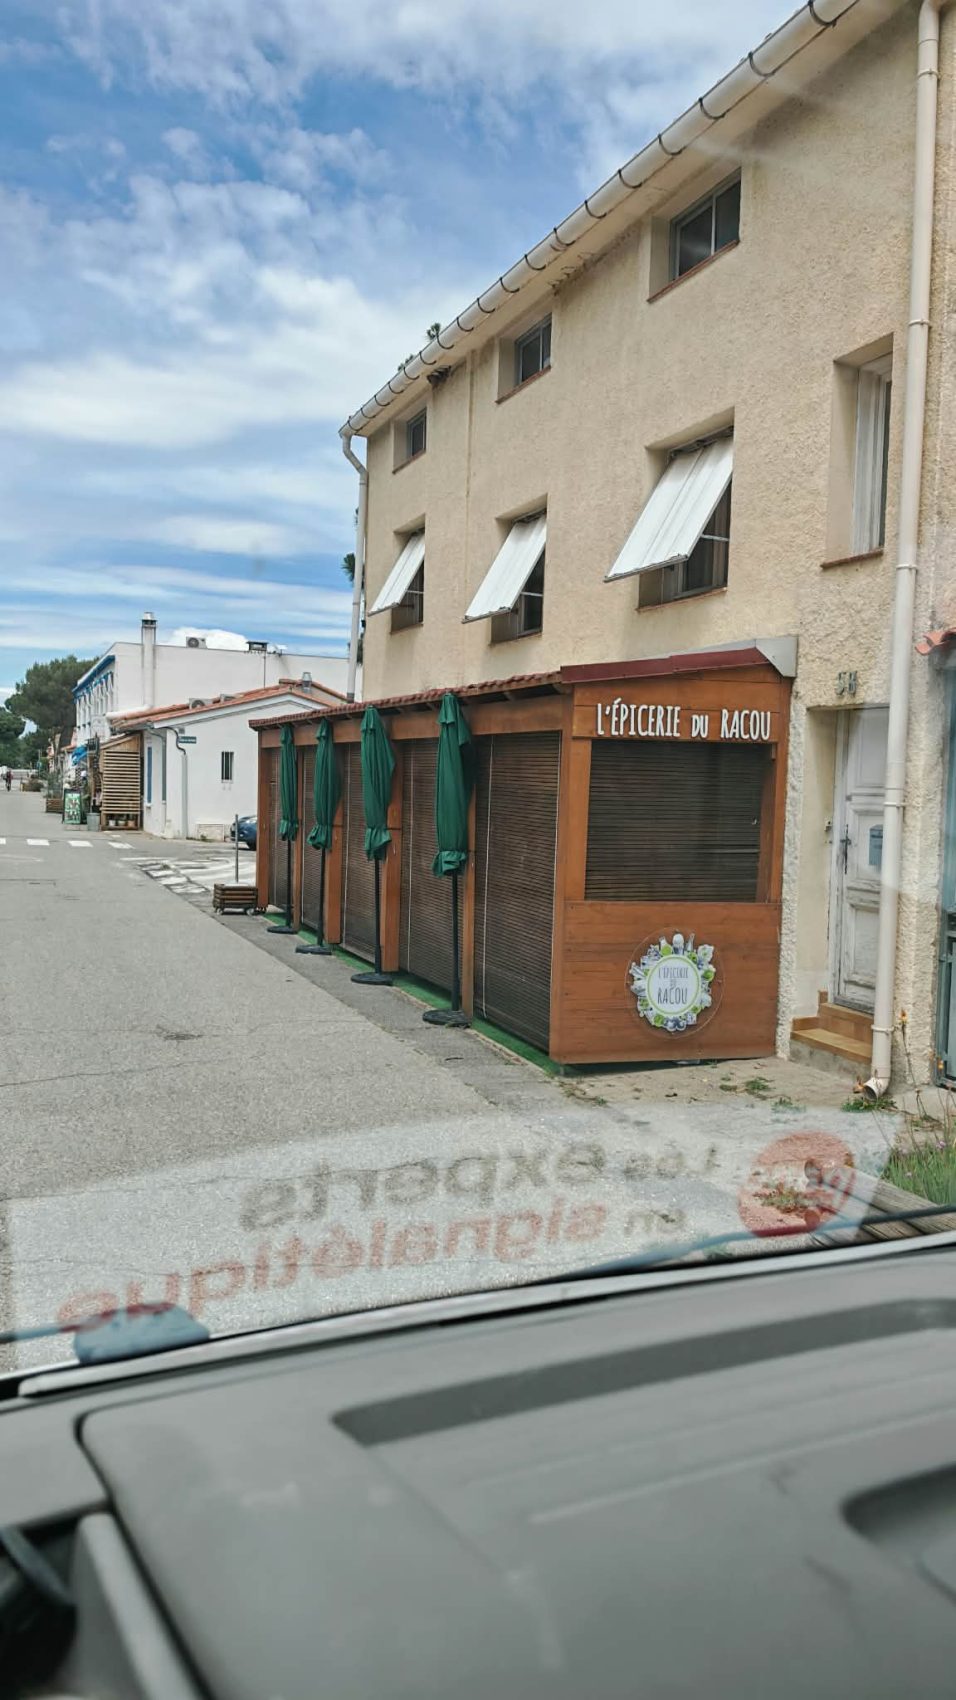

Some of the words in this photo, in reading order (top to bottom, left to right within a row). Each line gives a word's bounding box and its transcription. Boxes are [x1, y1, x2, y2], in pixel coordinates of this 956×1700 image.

[597, 697, 681, 737] L'ÉPICERIE
[691, 714, 709, 738] DU
[720, 708, 771, 740] RACOU
[657, 986, 688, 1005] RACOU
